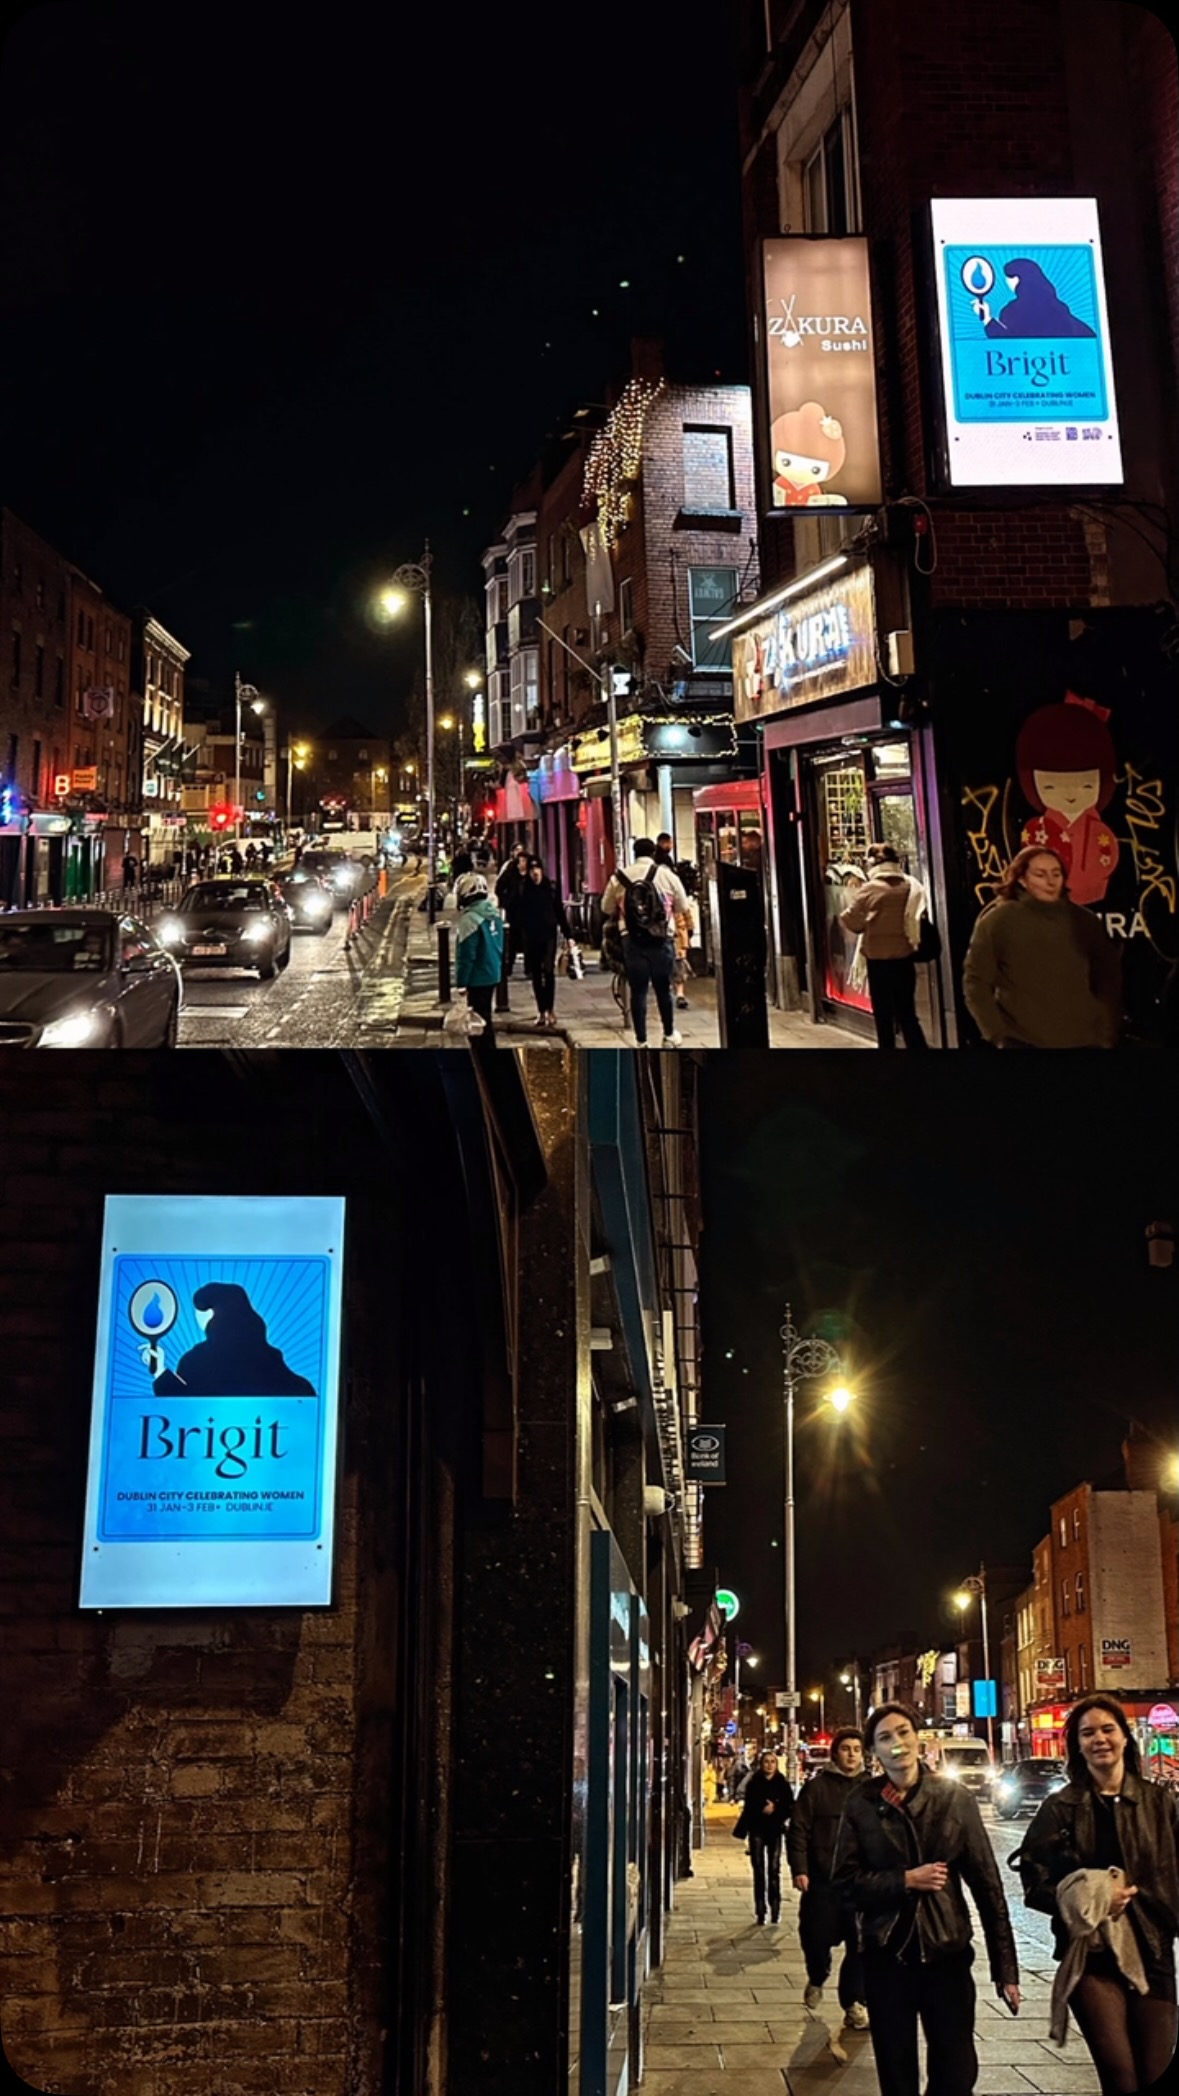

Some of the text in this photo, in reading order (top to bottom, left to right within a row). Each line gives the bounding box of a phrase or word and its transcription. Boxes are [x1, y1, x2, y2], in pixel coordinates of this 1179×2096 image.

[768, 306, 867, 337] ZAKURA
[821, 339, 867, 351] Sushi
[986, 350, 1070, 387] Brigit
[965, 392, 992, 400] DUBLIN
[1096, 912, 1151, 938] RA
[137, 1414, 289, 1479] Brigit
[117, 1491, 304, 1501] DUBLIN CITY CELEBRATING WOMEN
[1102, 1639, 1130, 1650] DNG
